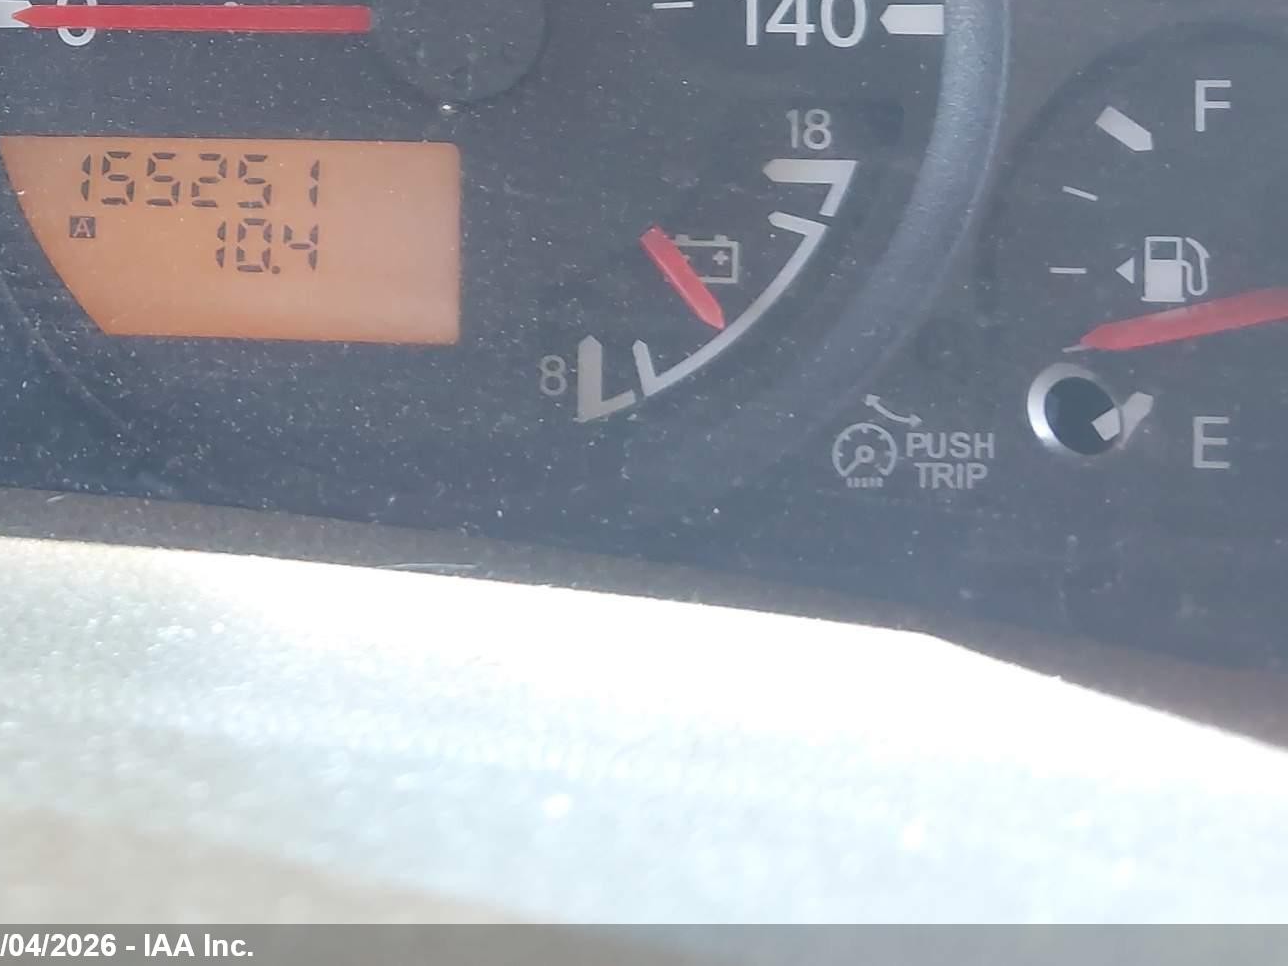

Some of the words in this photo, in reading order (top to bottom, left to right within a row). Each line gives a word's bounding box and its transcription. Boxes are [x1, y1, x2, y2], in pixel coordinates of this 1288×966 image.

[786, 109, 833, 149] 18
[1194, 79, 1232, 132] F
[79, 150, 320, 208] 155251
[216, 217, 319, 273] 10.4
[539, 354, 567, 396] 8
[906, 433, 995, 460] PUSH
[1192, 417, 1231, 469] E
[913, 462, 989, 489] TRIP
